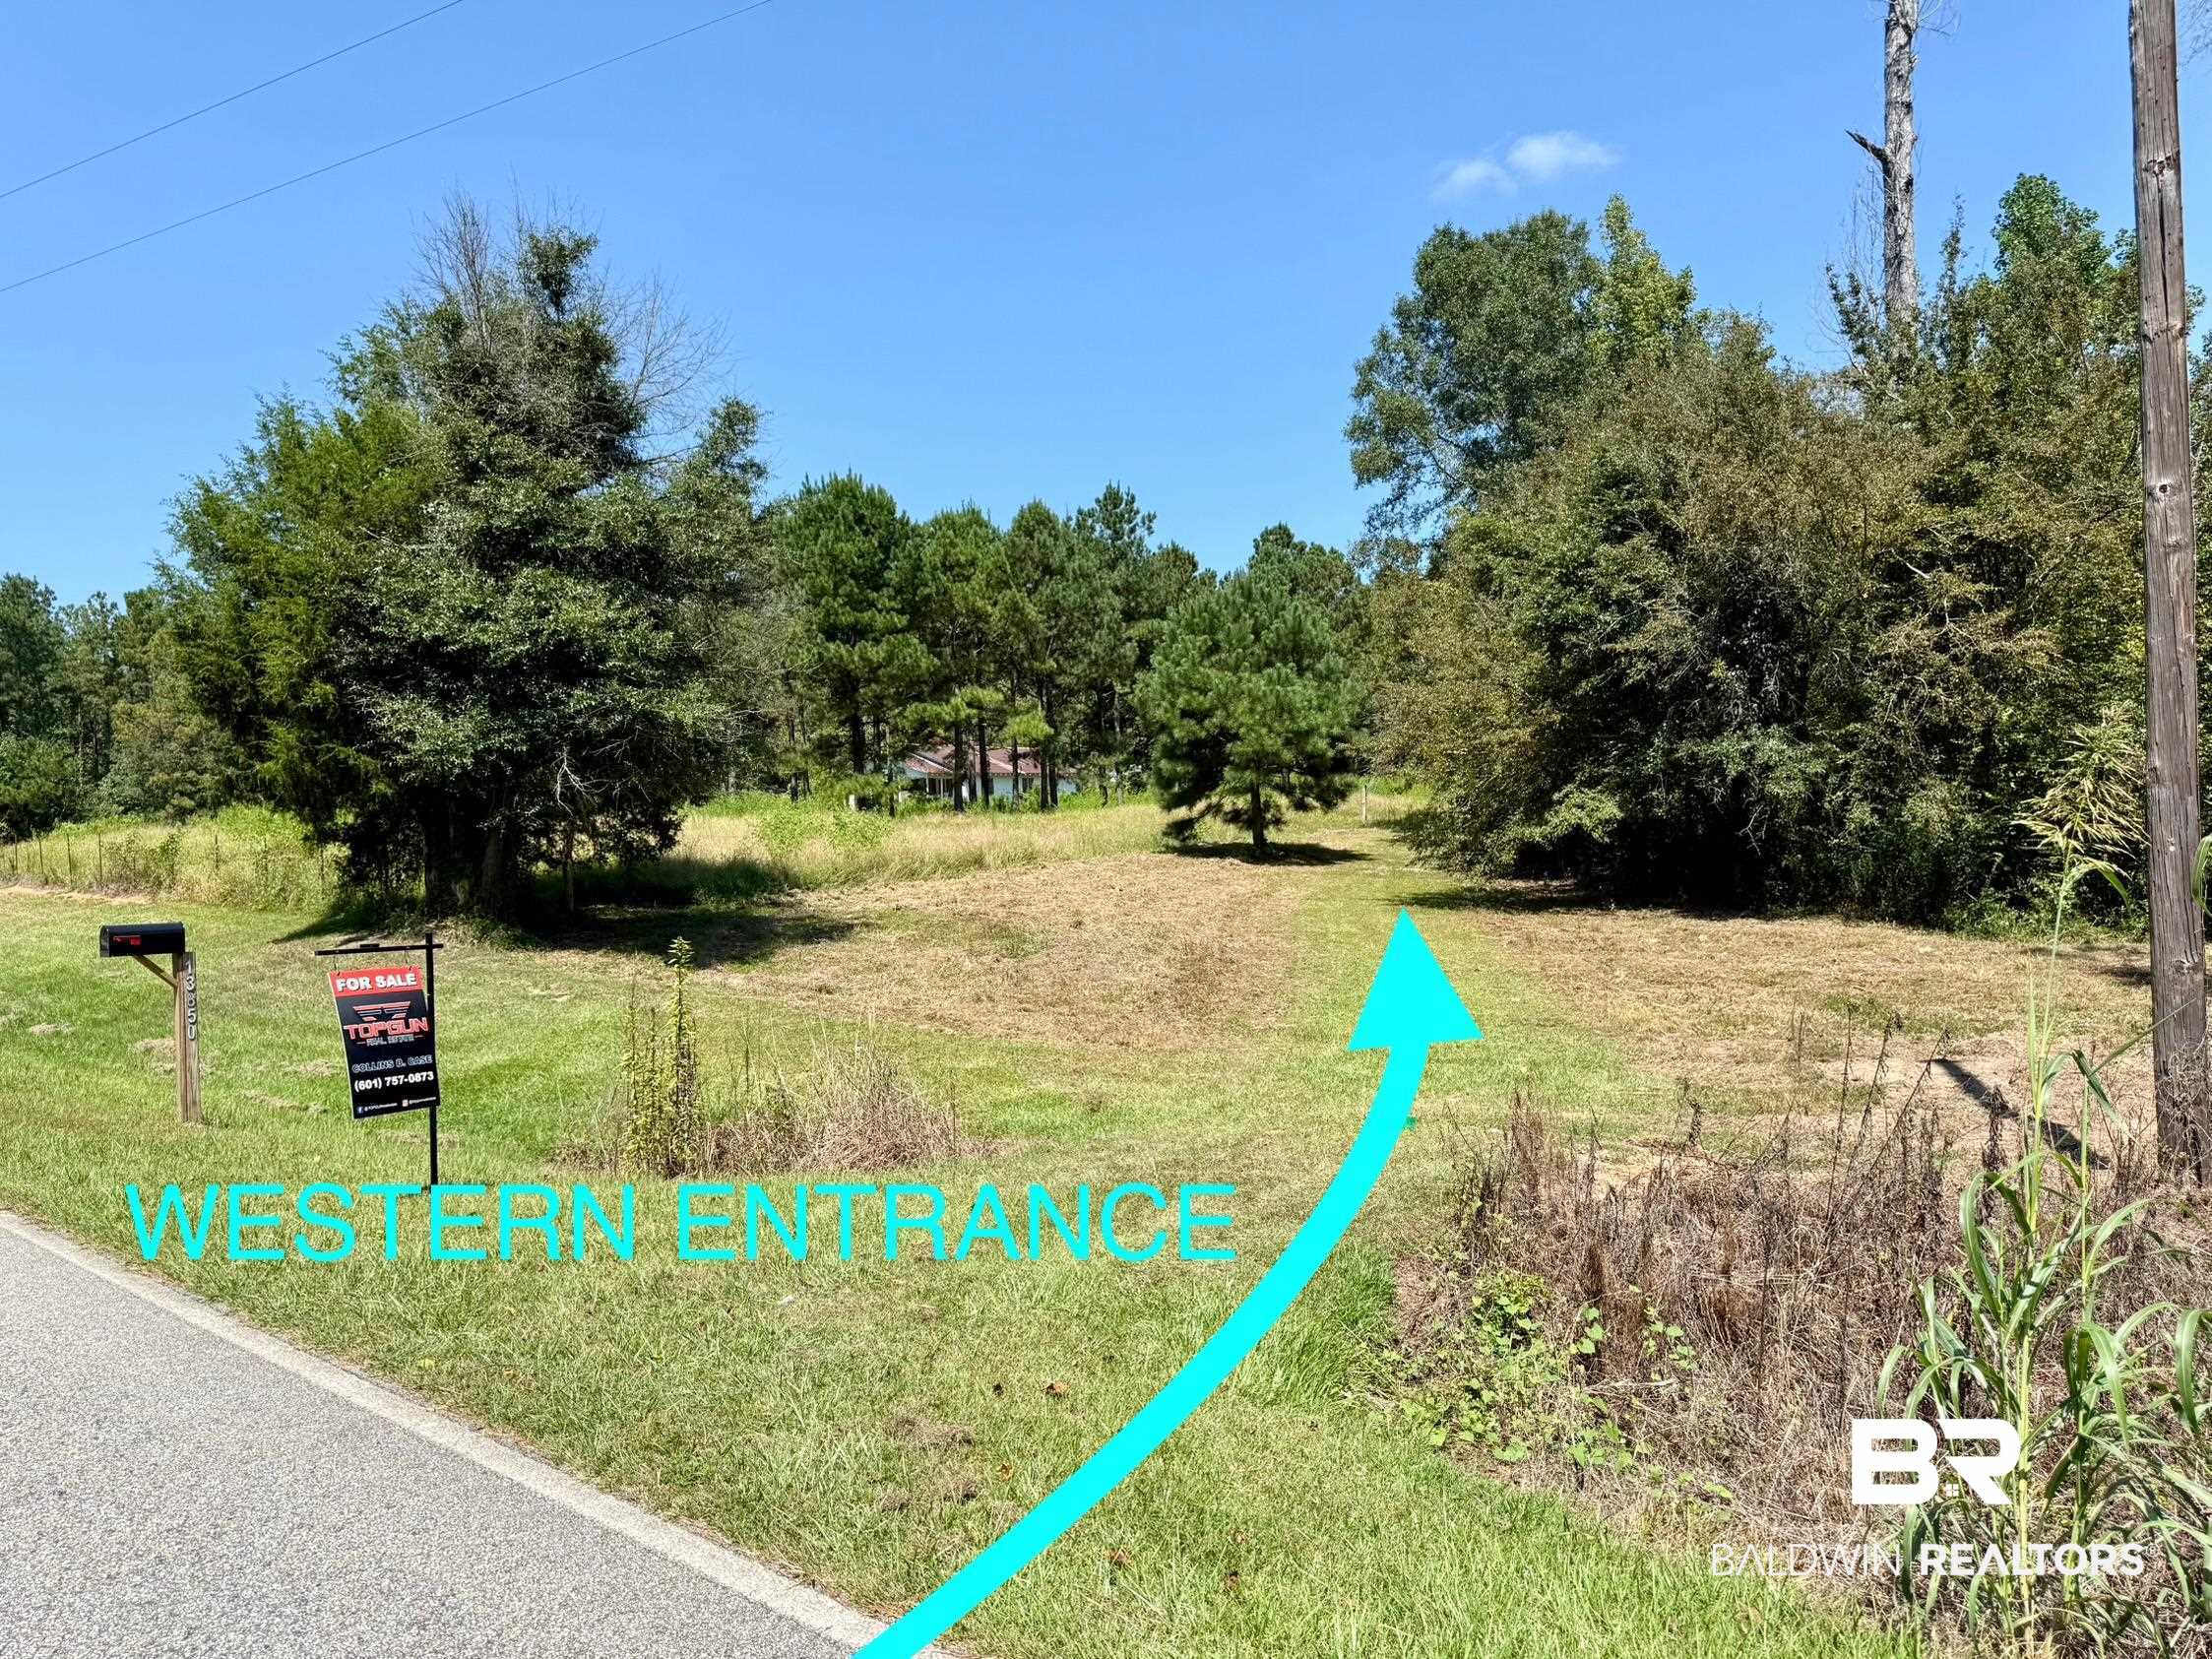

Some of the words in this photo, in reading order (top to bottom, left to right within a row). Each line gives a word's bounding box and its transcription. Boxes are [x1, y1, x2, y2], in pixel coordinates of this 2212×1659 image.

[336, 976, 373, 992] FOR
[375, 973, 417, 989] SALE
[343, 1016, 429, 1040] TOPGUN
[351, 1058, 395, 1073] COLLINS
[408, 1054, 433, 1066] CASE
[353, 1077, 382, 1093] (601)
[384, 1070, 434, 1087] 757-0873
